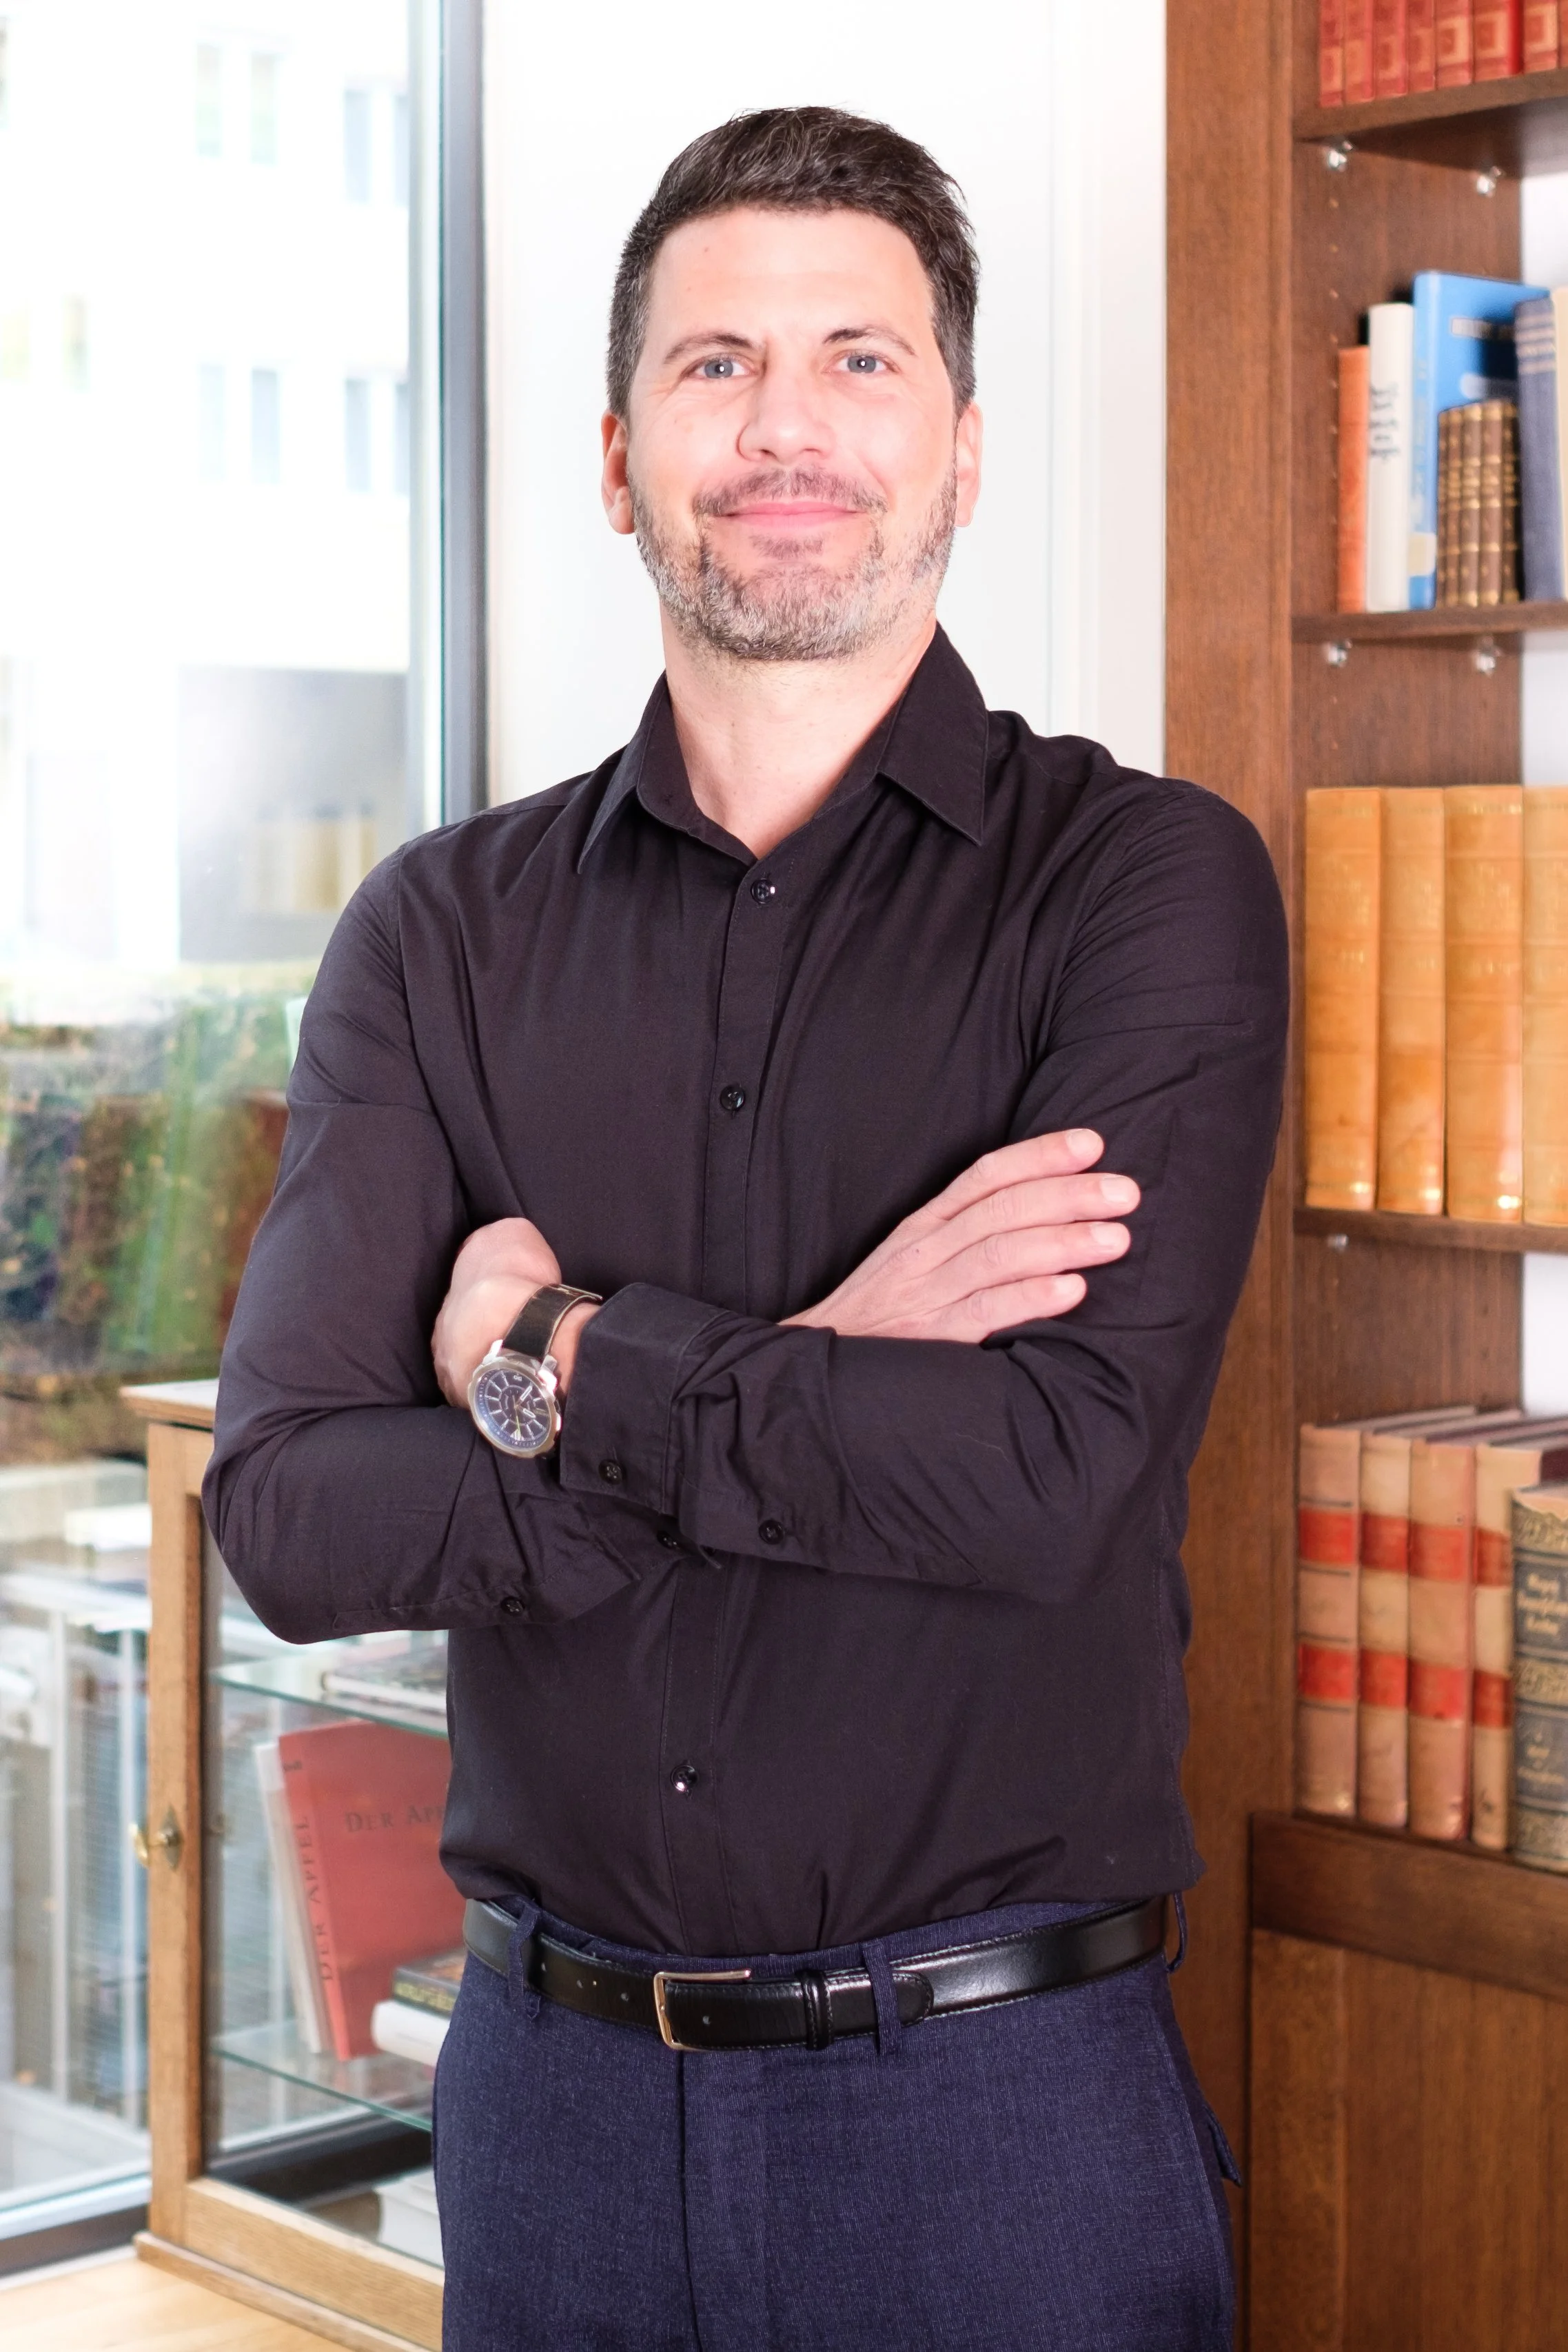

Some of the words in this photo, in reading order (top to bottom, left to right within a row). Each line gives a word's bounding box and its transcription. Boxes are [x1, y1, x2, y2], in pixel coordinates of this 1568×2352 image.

[345, 1812, 394, 1833] DER
[296, 1816, 320, 1903] APFEL
[315, 1923, 334, 1980] DER
